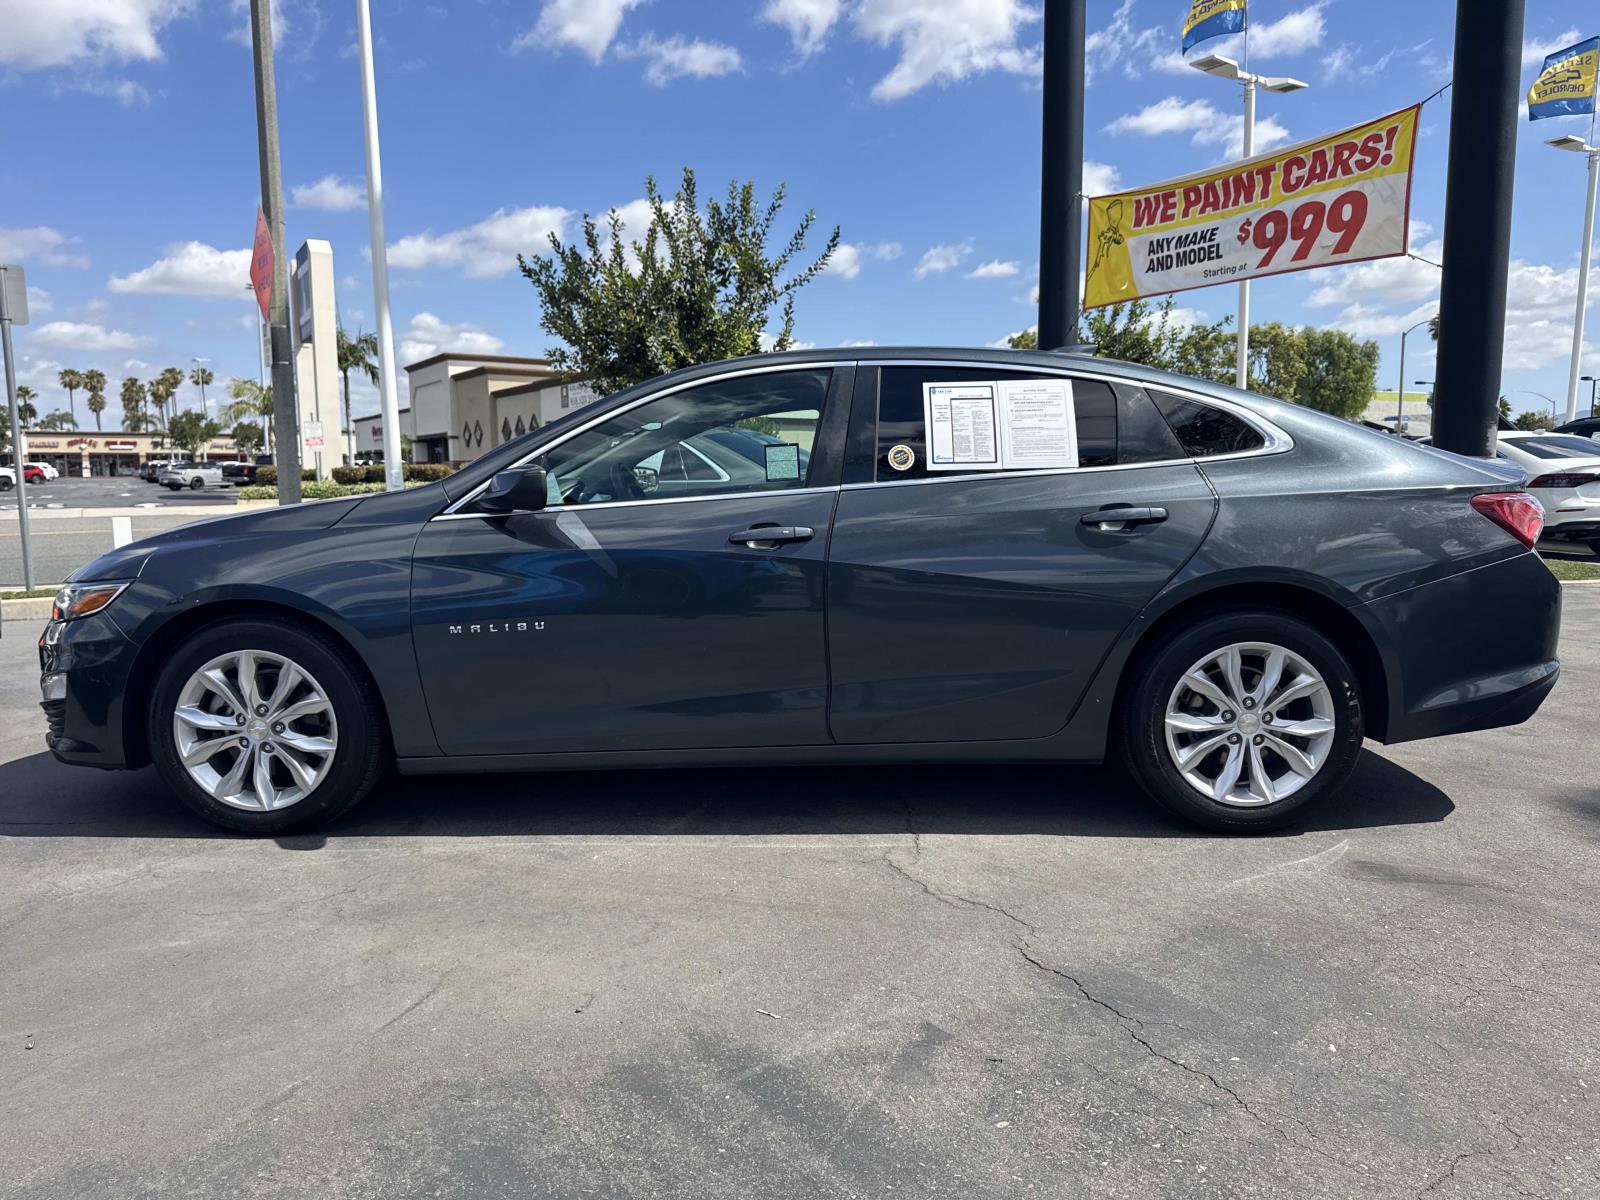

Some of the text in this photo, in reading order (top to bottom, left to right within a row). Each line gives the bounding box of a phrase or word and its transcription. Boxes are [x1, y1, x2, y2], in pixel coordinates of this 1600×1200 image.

[1133, 125, 1399, 228] WE PAINT CARS!
[1148, 226, 1220, 257] ANY MAKE
[1237, 189, 1368, 270] $999
[1146, 243, 1223, 274] AND MODEL
[1203, 263, 1248, 279] Starting at
[449, 621, 545, 635] MALIBU
